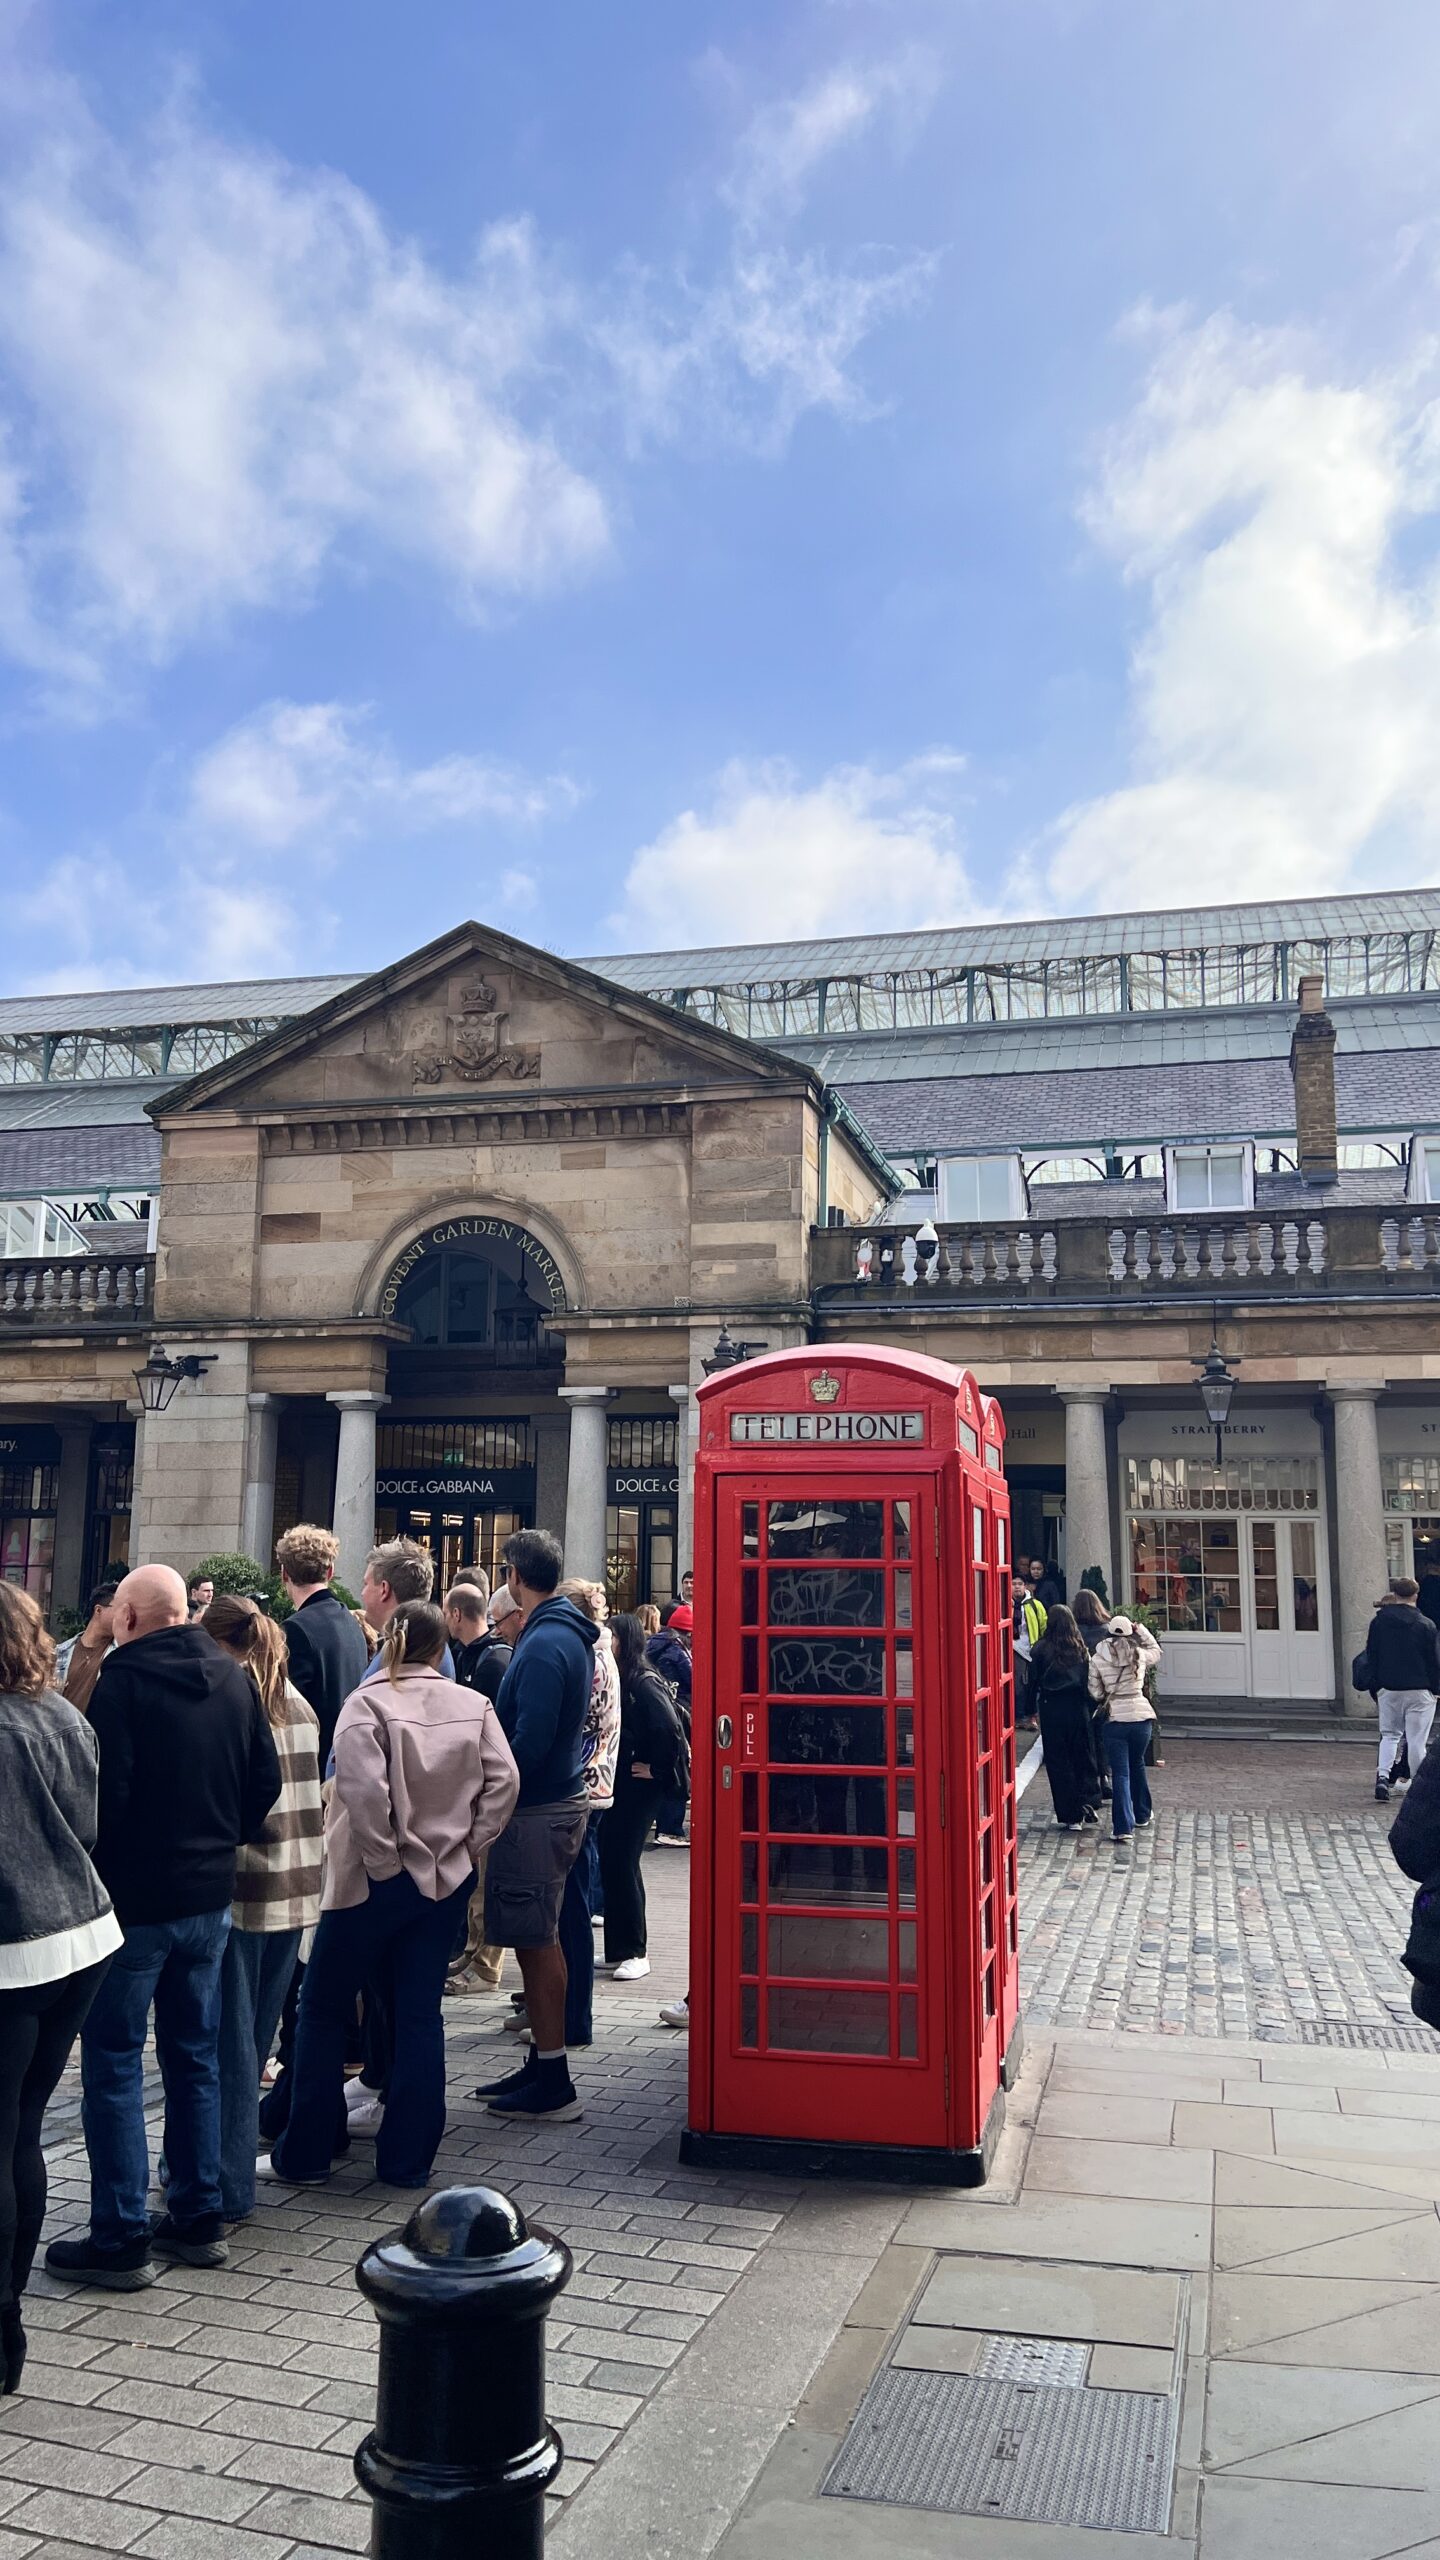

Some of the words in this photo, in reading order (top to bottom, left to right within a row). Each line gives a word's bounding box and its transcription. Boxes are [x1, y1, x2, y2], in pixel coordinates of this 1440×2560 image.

[382, 1240, 427, 1315] COVENT
[432, 1220, 515, 1244] GARDEN
[516, 1233, 567, 1312] MARKET
[738, 1415, 916, 1440] TELEPHONE
[1010, 1427, 1036, 1439] Hall
[376, 1480, 418, 1494] DOLCE
[426, 1480, 494, 1494] GABBANA
[615, 1478, 660, 1492] DOLCE
[746, 1713, 754, 1755] PULL
